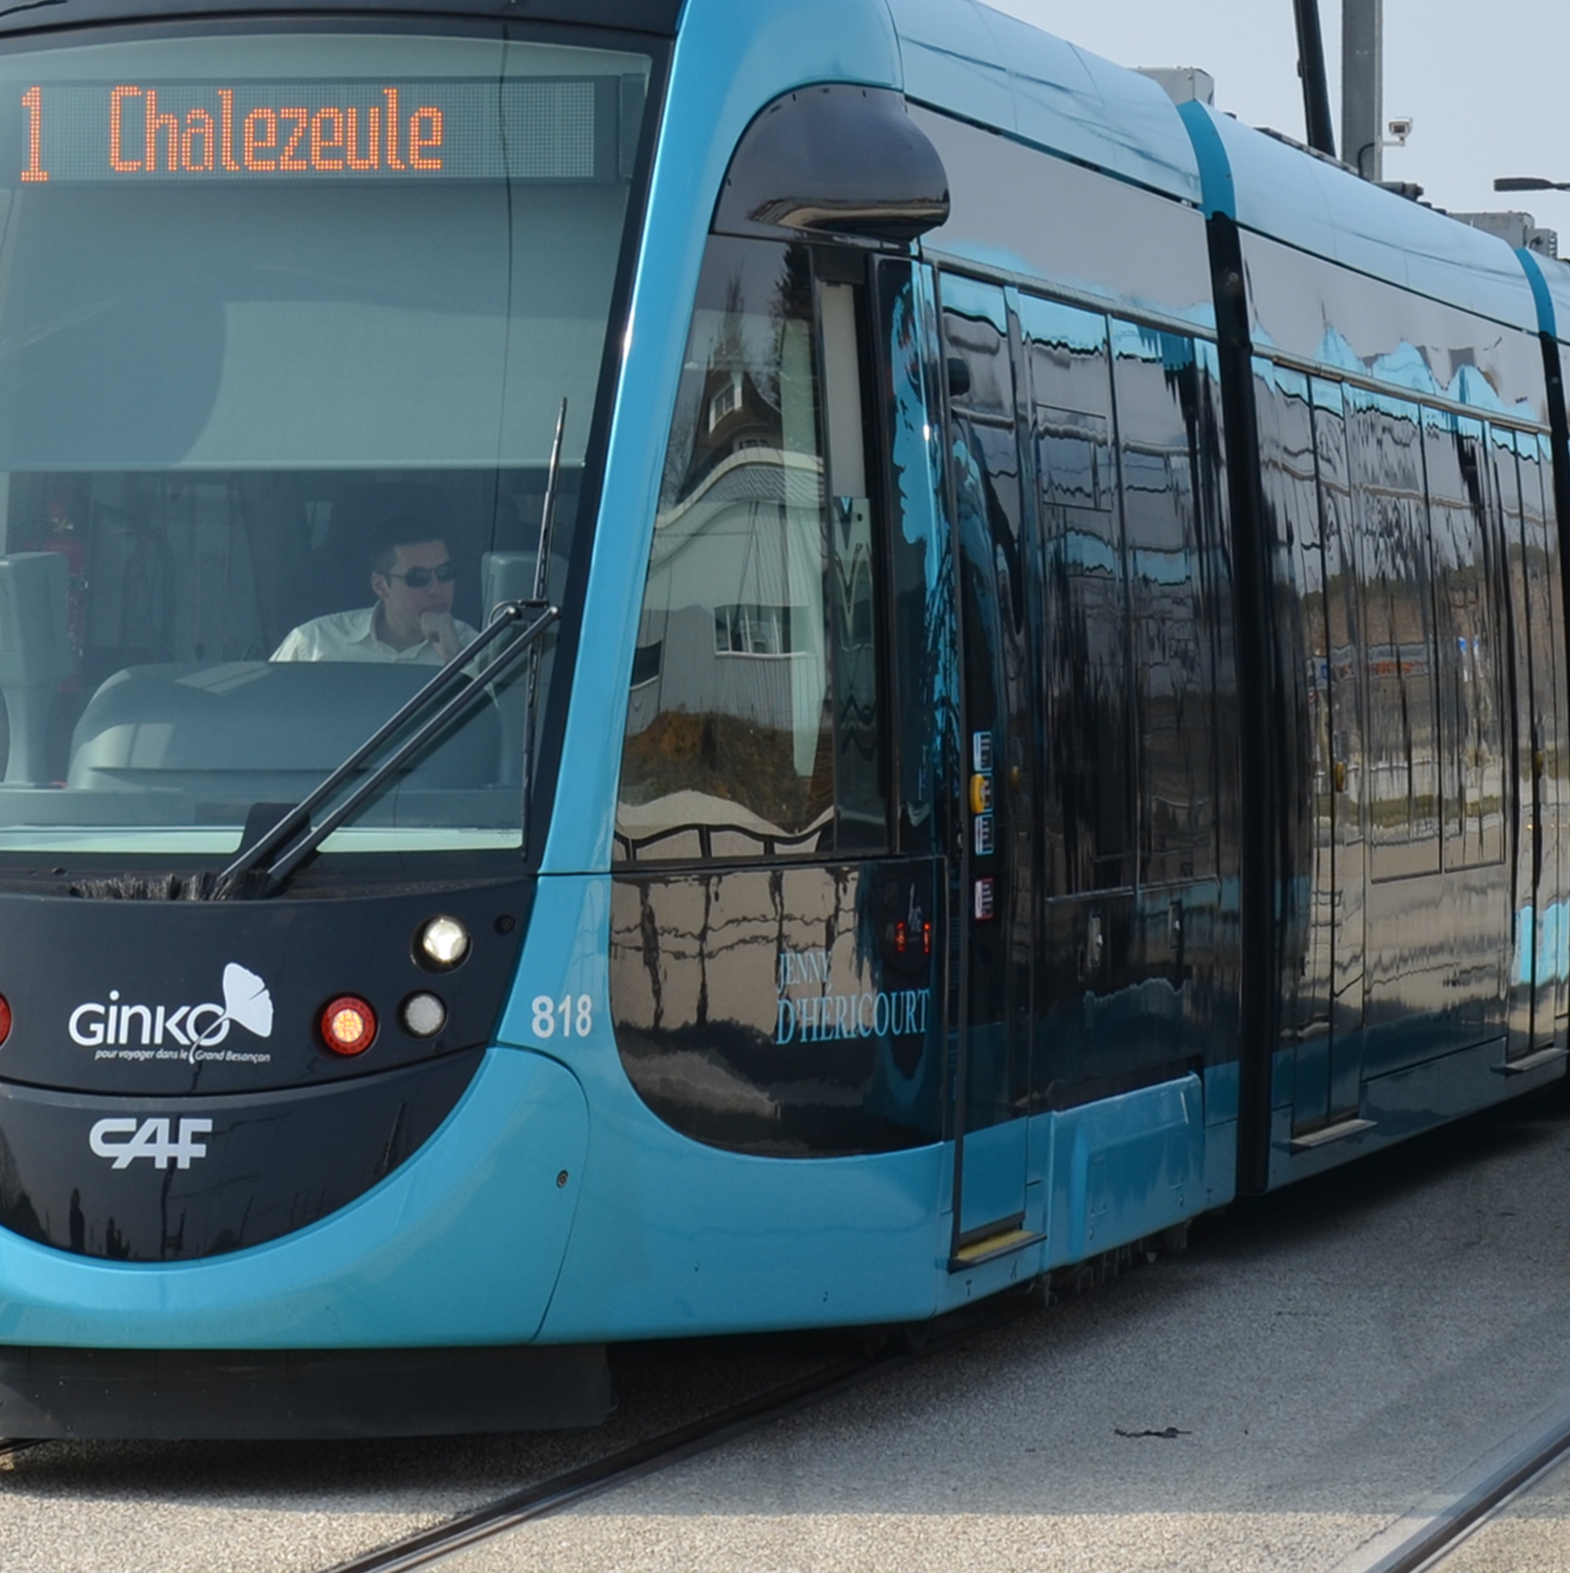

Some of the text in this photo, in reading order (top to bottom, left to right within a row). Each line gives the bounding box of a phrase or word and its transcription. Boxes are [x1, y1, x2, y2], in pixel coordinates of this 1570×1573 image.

[20, 85, 444, 183] 1 Chalezeule
[777, 951, 832, 994] JENNY
[530, 992, 595, 1039] 818
[94, 1048, 271, 1064] pour voyager dans le Grand Besançon
[87, 1116, 215, 1170] CAF
